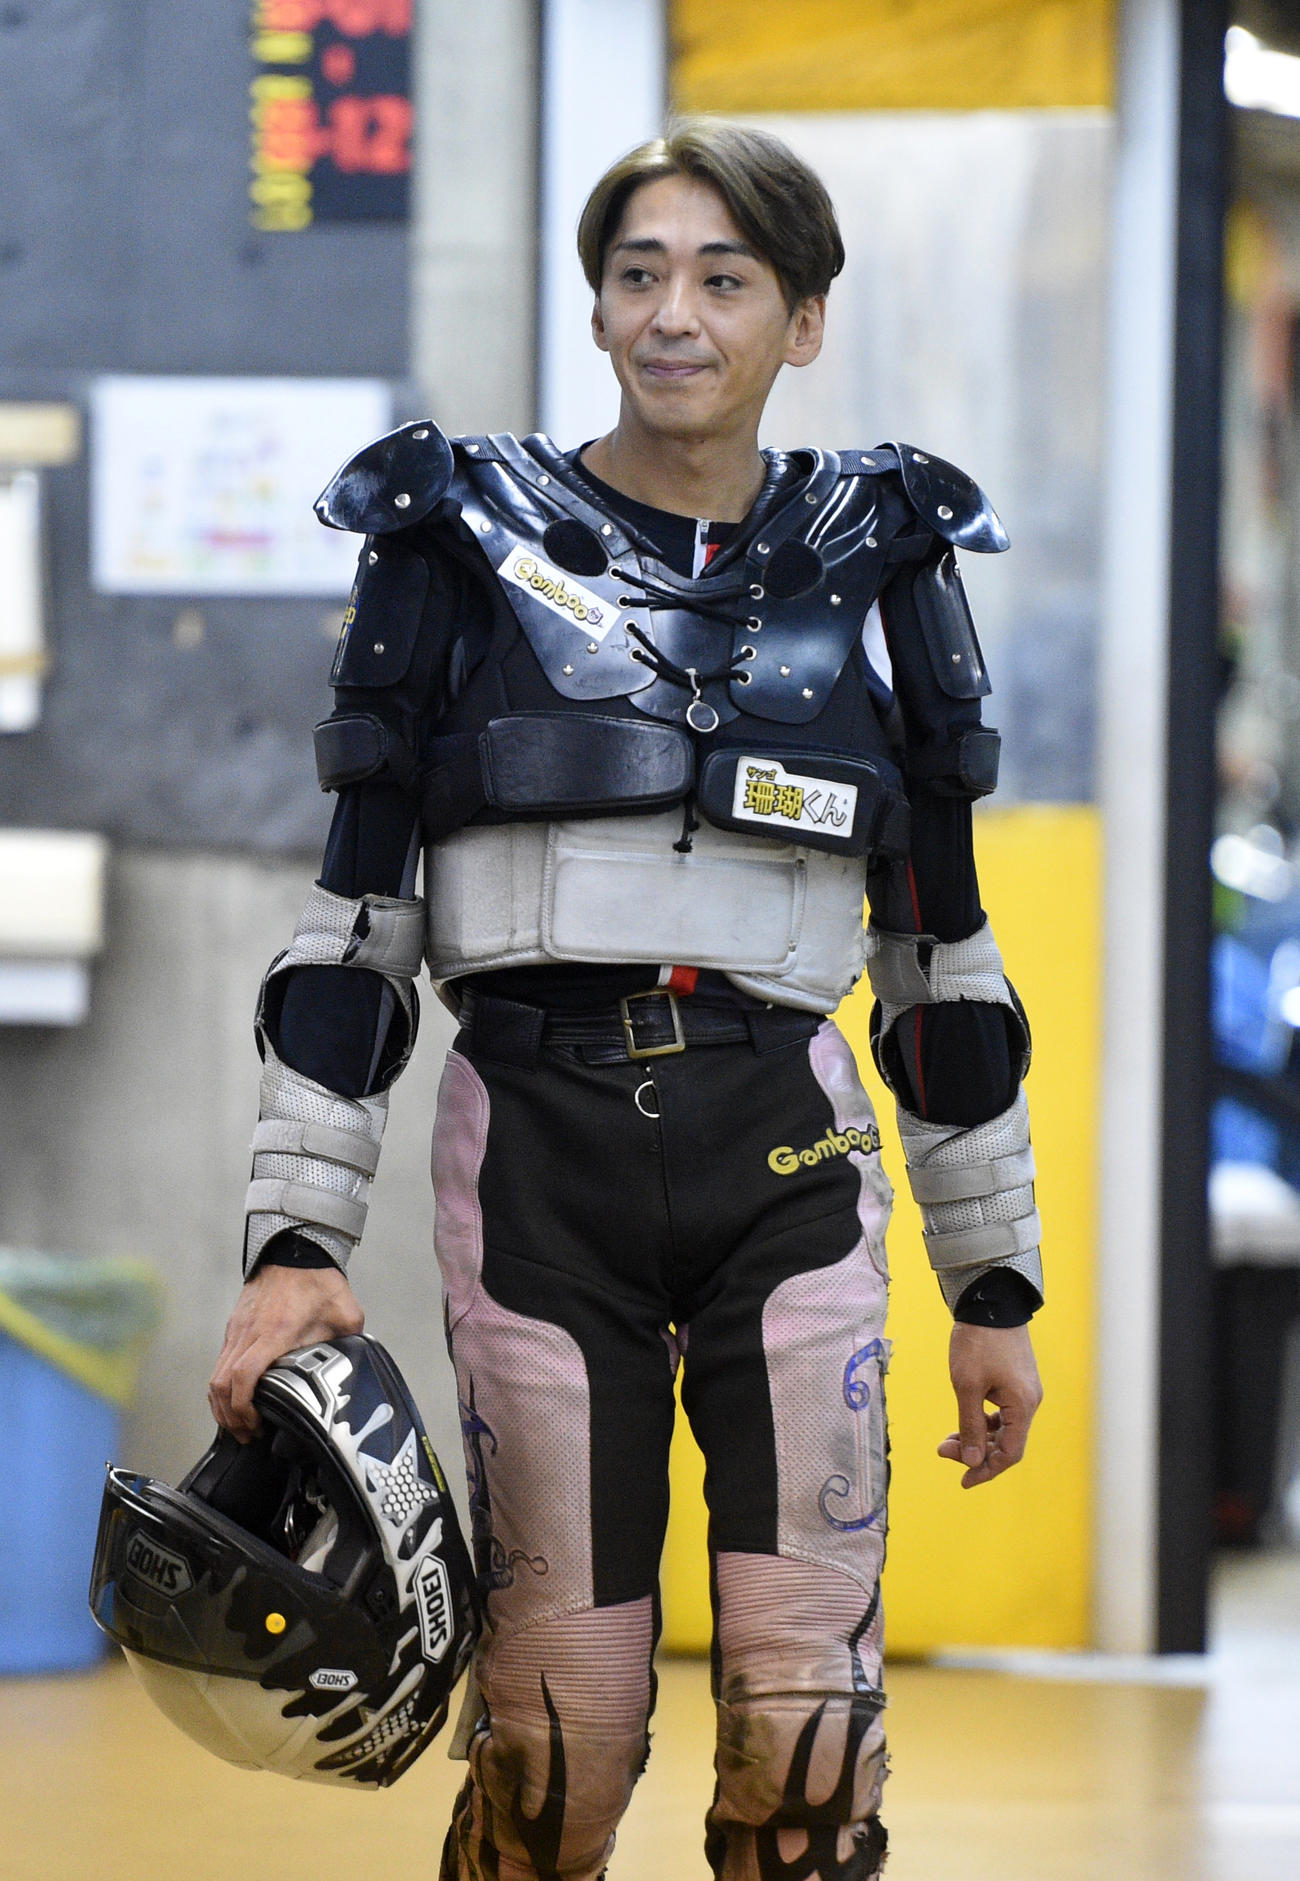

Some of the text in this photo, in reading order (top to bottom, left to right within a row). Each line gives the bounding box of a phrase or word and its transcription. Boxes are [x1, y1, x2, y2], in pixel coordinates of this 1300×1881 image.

[747, 766, 777, 780] サンゴ
[744, 780, 847, 826] 珊瑚くん
[128, 1539, 182, 1589] SHOEI
[421, 1568, 447, 1649] SHOEI
[317, 1673, 350, 1686] SHOEI
